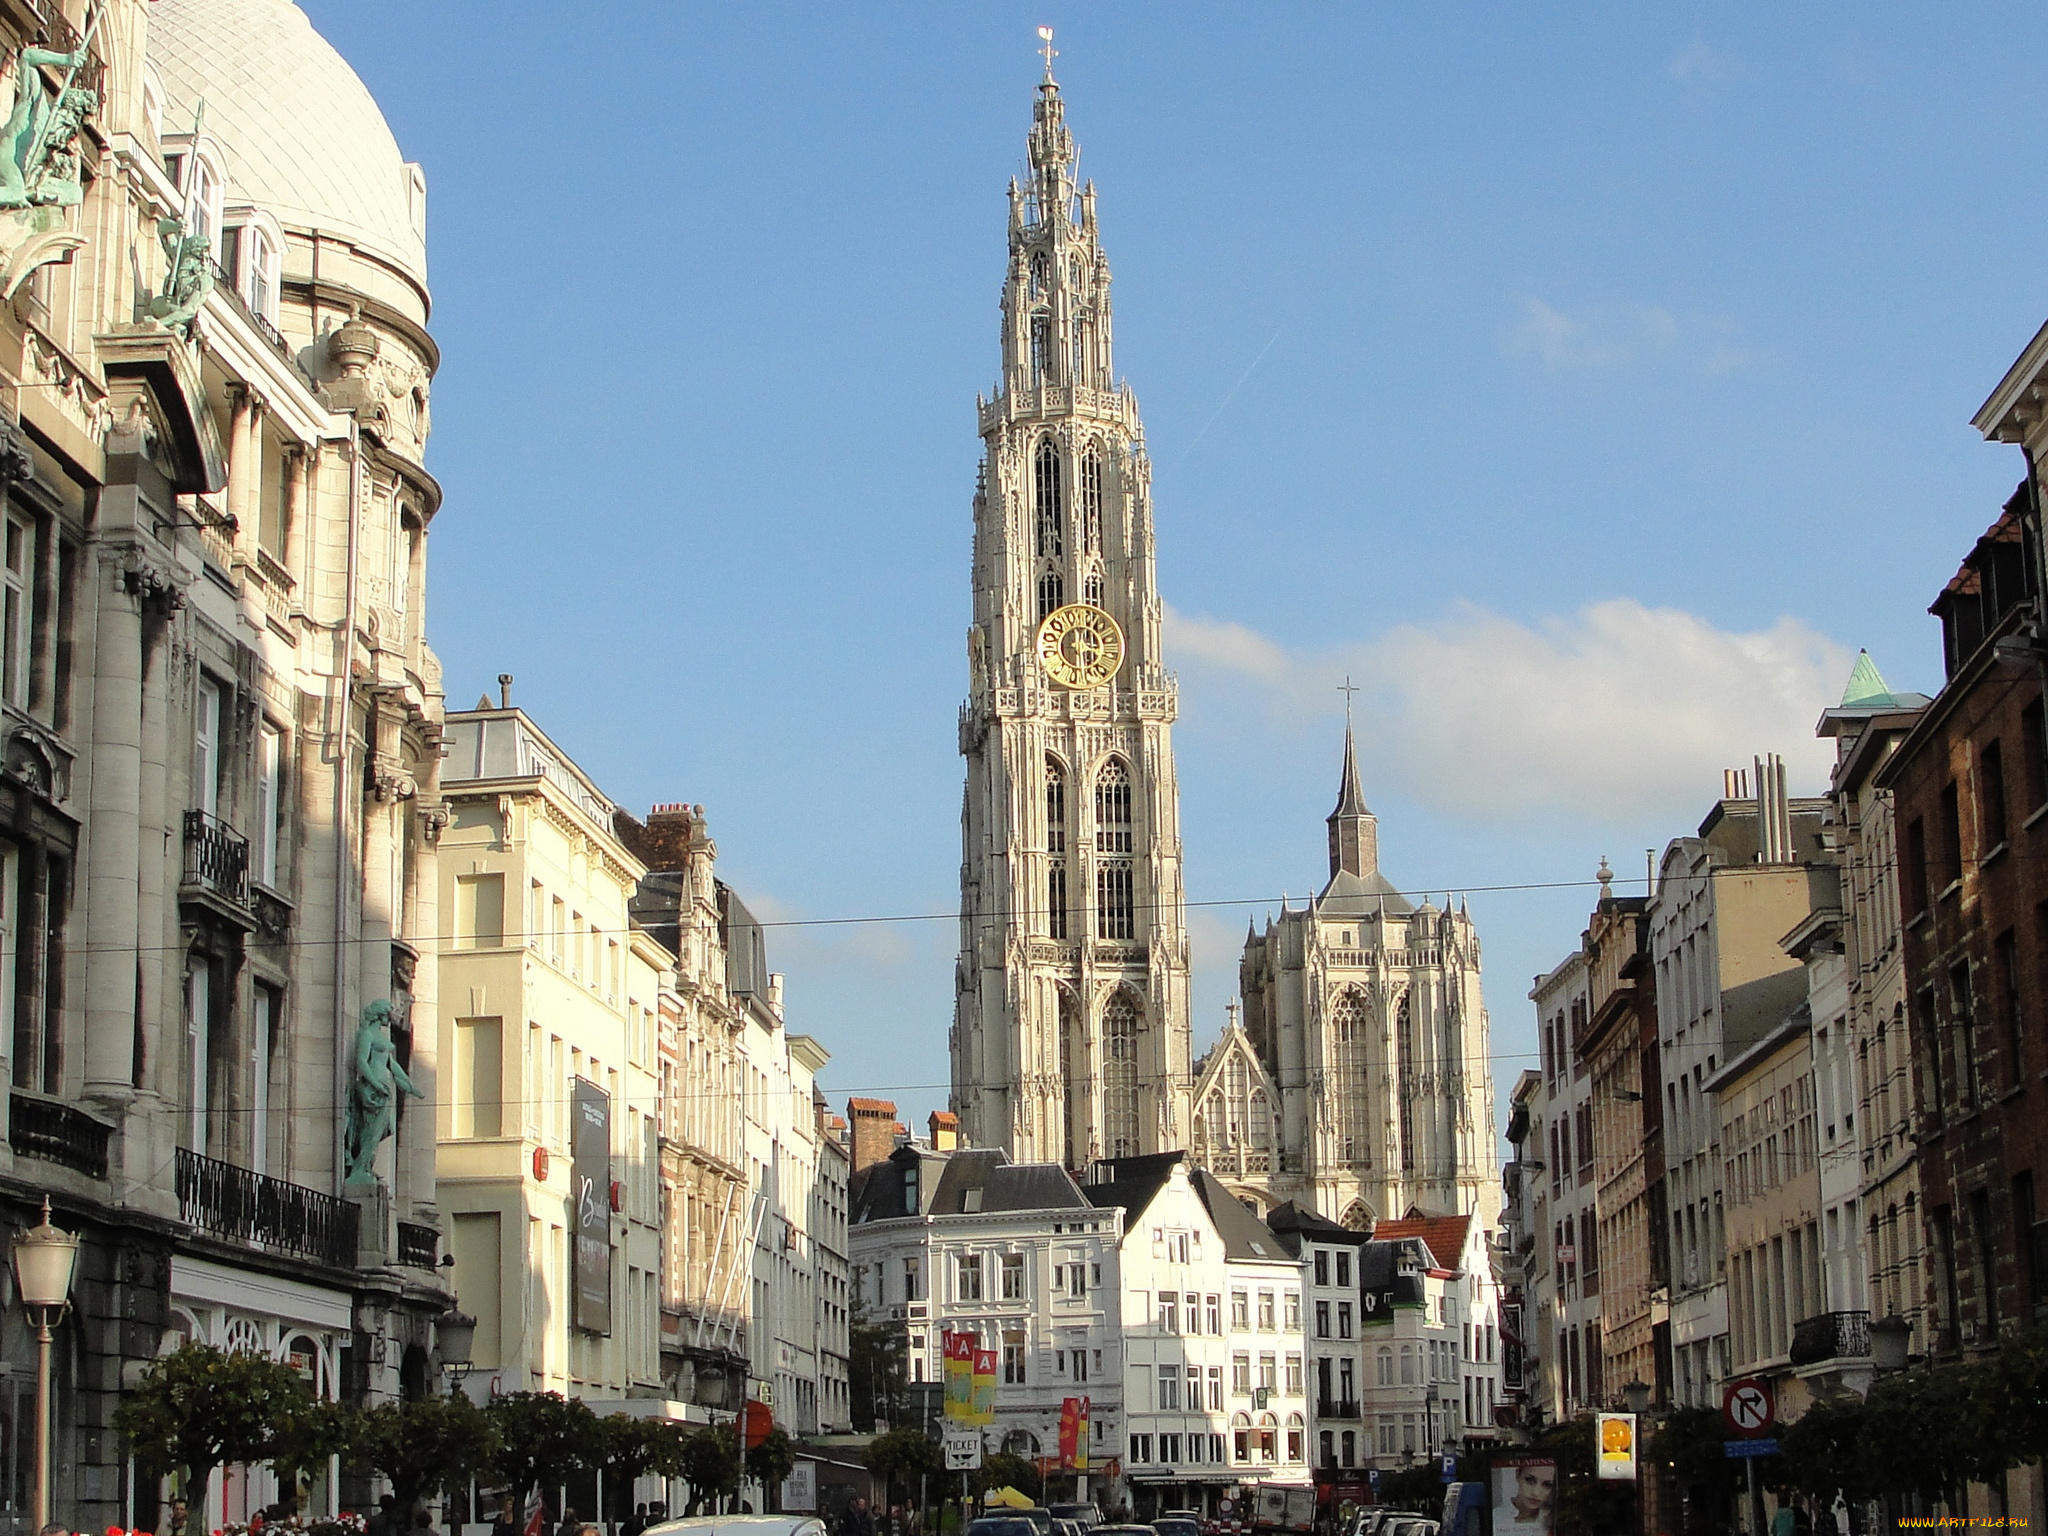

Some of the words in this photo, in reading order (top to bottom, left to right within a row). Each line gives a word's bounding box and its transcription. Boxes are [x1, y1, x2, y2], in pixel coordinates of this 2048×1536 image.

[959, 1340, 969, 1355] A
[979, 1355, 990, 1369] A
[948, 1440, 977, 1450] TICKET
[1443, 1457, 1454, 1472] P
[1369, 1470, 1378, 1483] P
